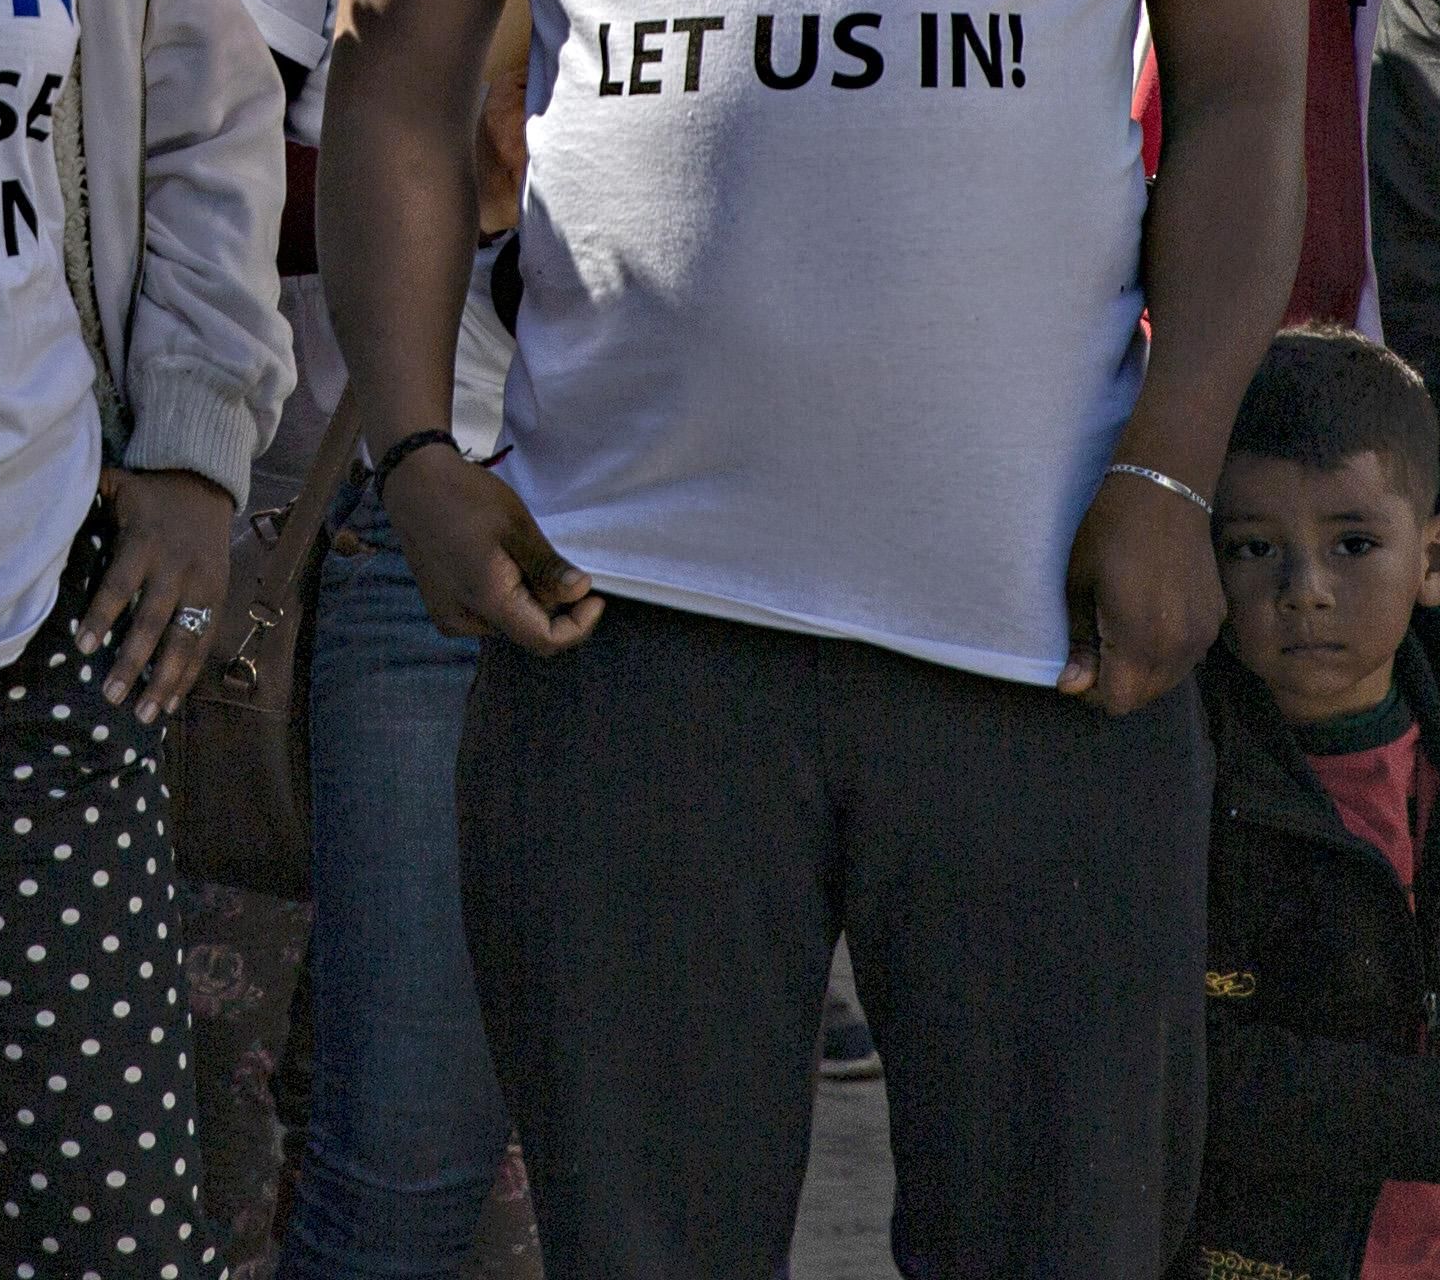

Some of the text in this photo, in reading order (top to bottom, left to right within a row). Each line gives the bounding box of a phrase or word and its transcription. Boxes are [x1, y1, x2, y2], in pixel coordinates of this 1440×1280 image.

[598, 12, 1028, 97] LET US IN!
